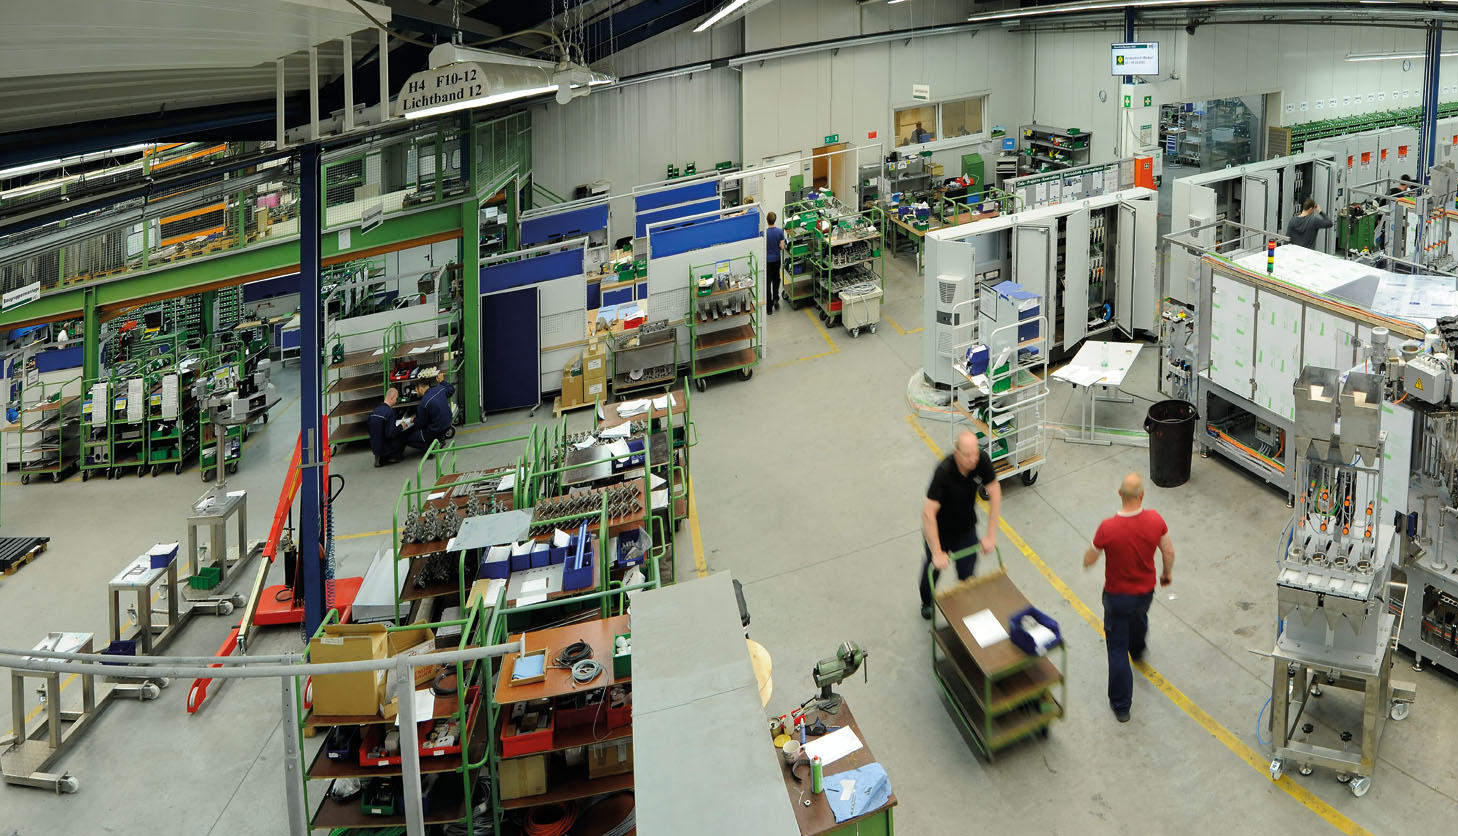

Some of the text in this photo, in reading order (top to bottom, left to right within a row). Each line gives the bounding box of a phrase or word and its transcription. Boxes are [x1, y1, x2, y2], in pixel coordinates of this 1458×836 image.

[408, 69, 477, 94] H4 F10-12
[403, 84, 482, 110] Lichtband 12
